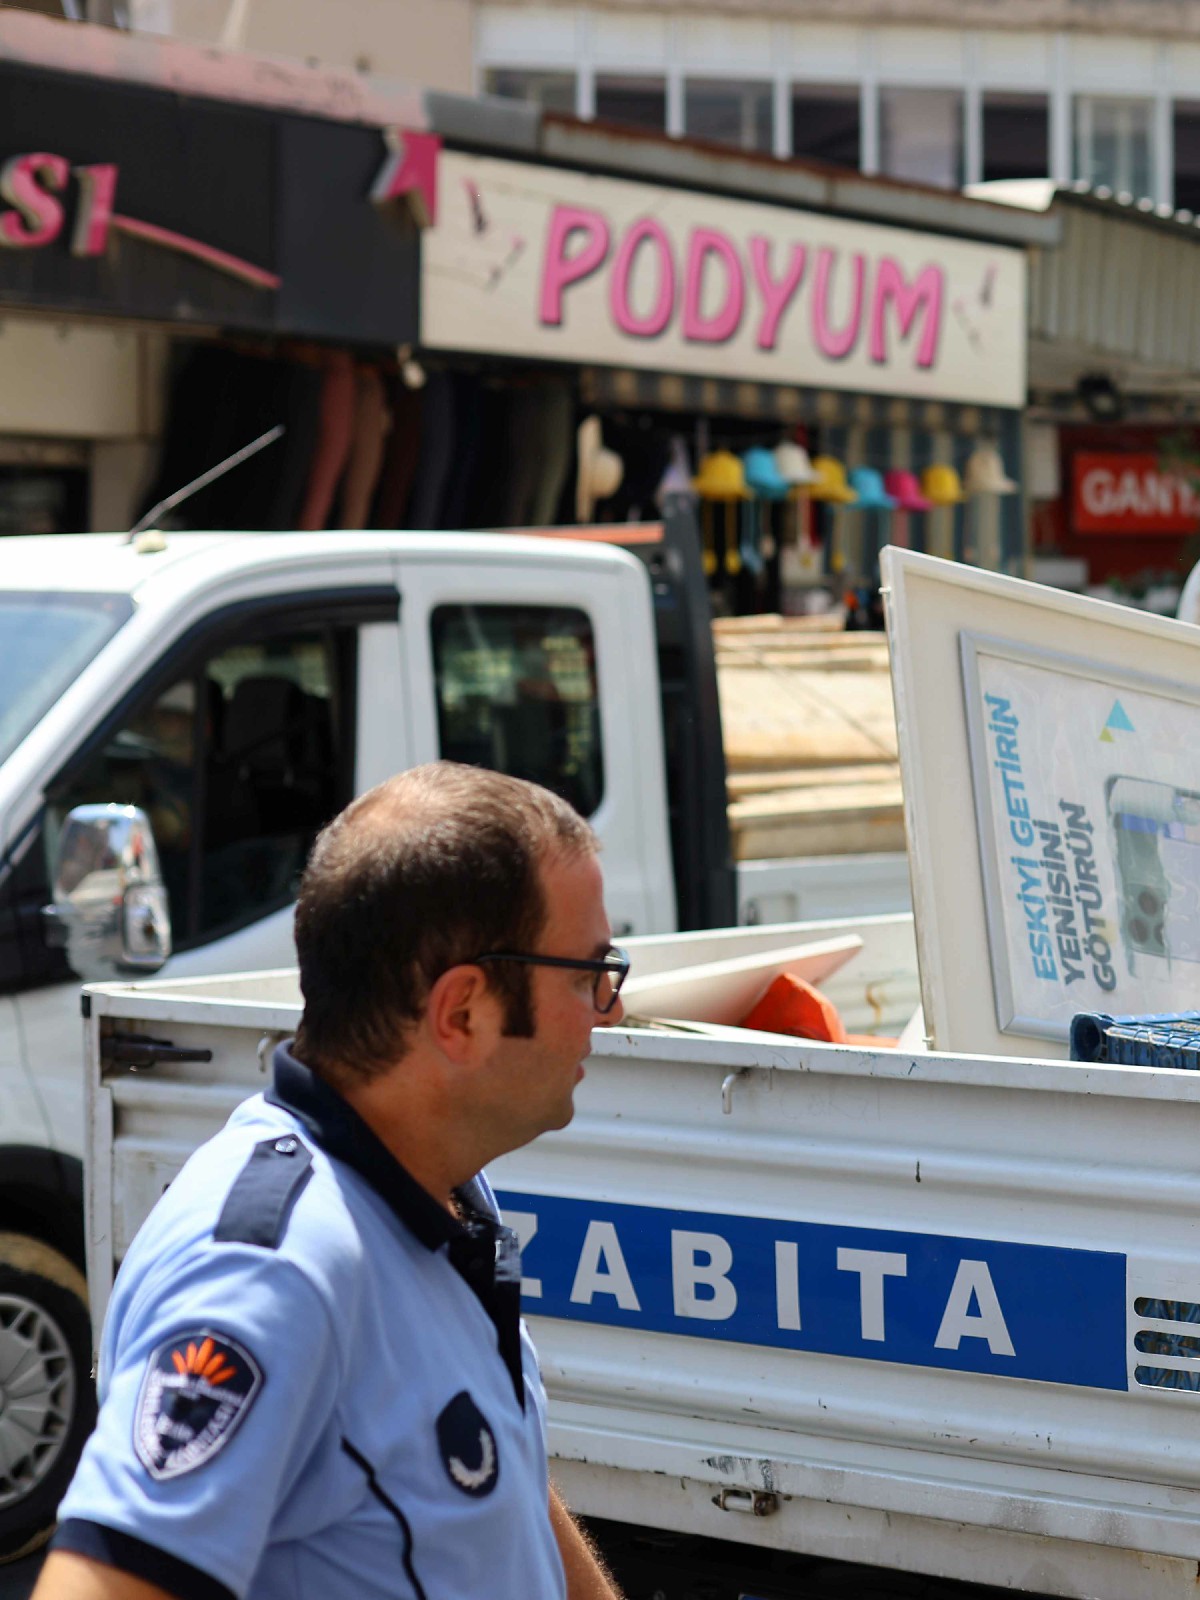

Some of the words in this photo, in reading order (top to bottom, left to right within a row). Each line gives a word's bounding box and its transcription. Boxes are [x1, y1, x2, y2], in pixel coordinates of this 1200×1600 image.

[539, 203, 946, 370] PODYUM
[984, 691, 1035, 847] GETİRİN
[1010, 856, 1059, 981] ESKİYİ
[1032, 819, 1086, 986] YENİSİNİ
[1058, 798, 1117, 991] GÖTÜRÜN
